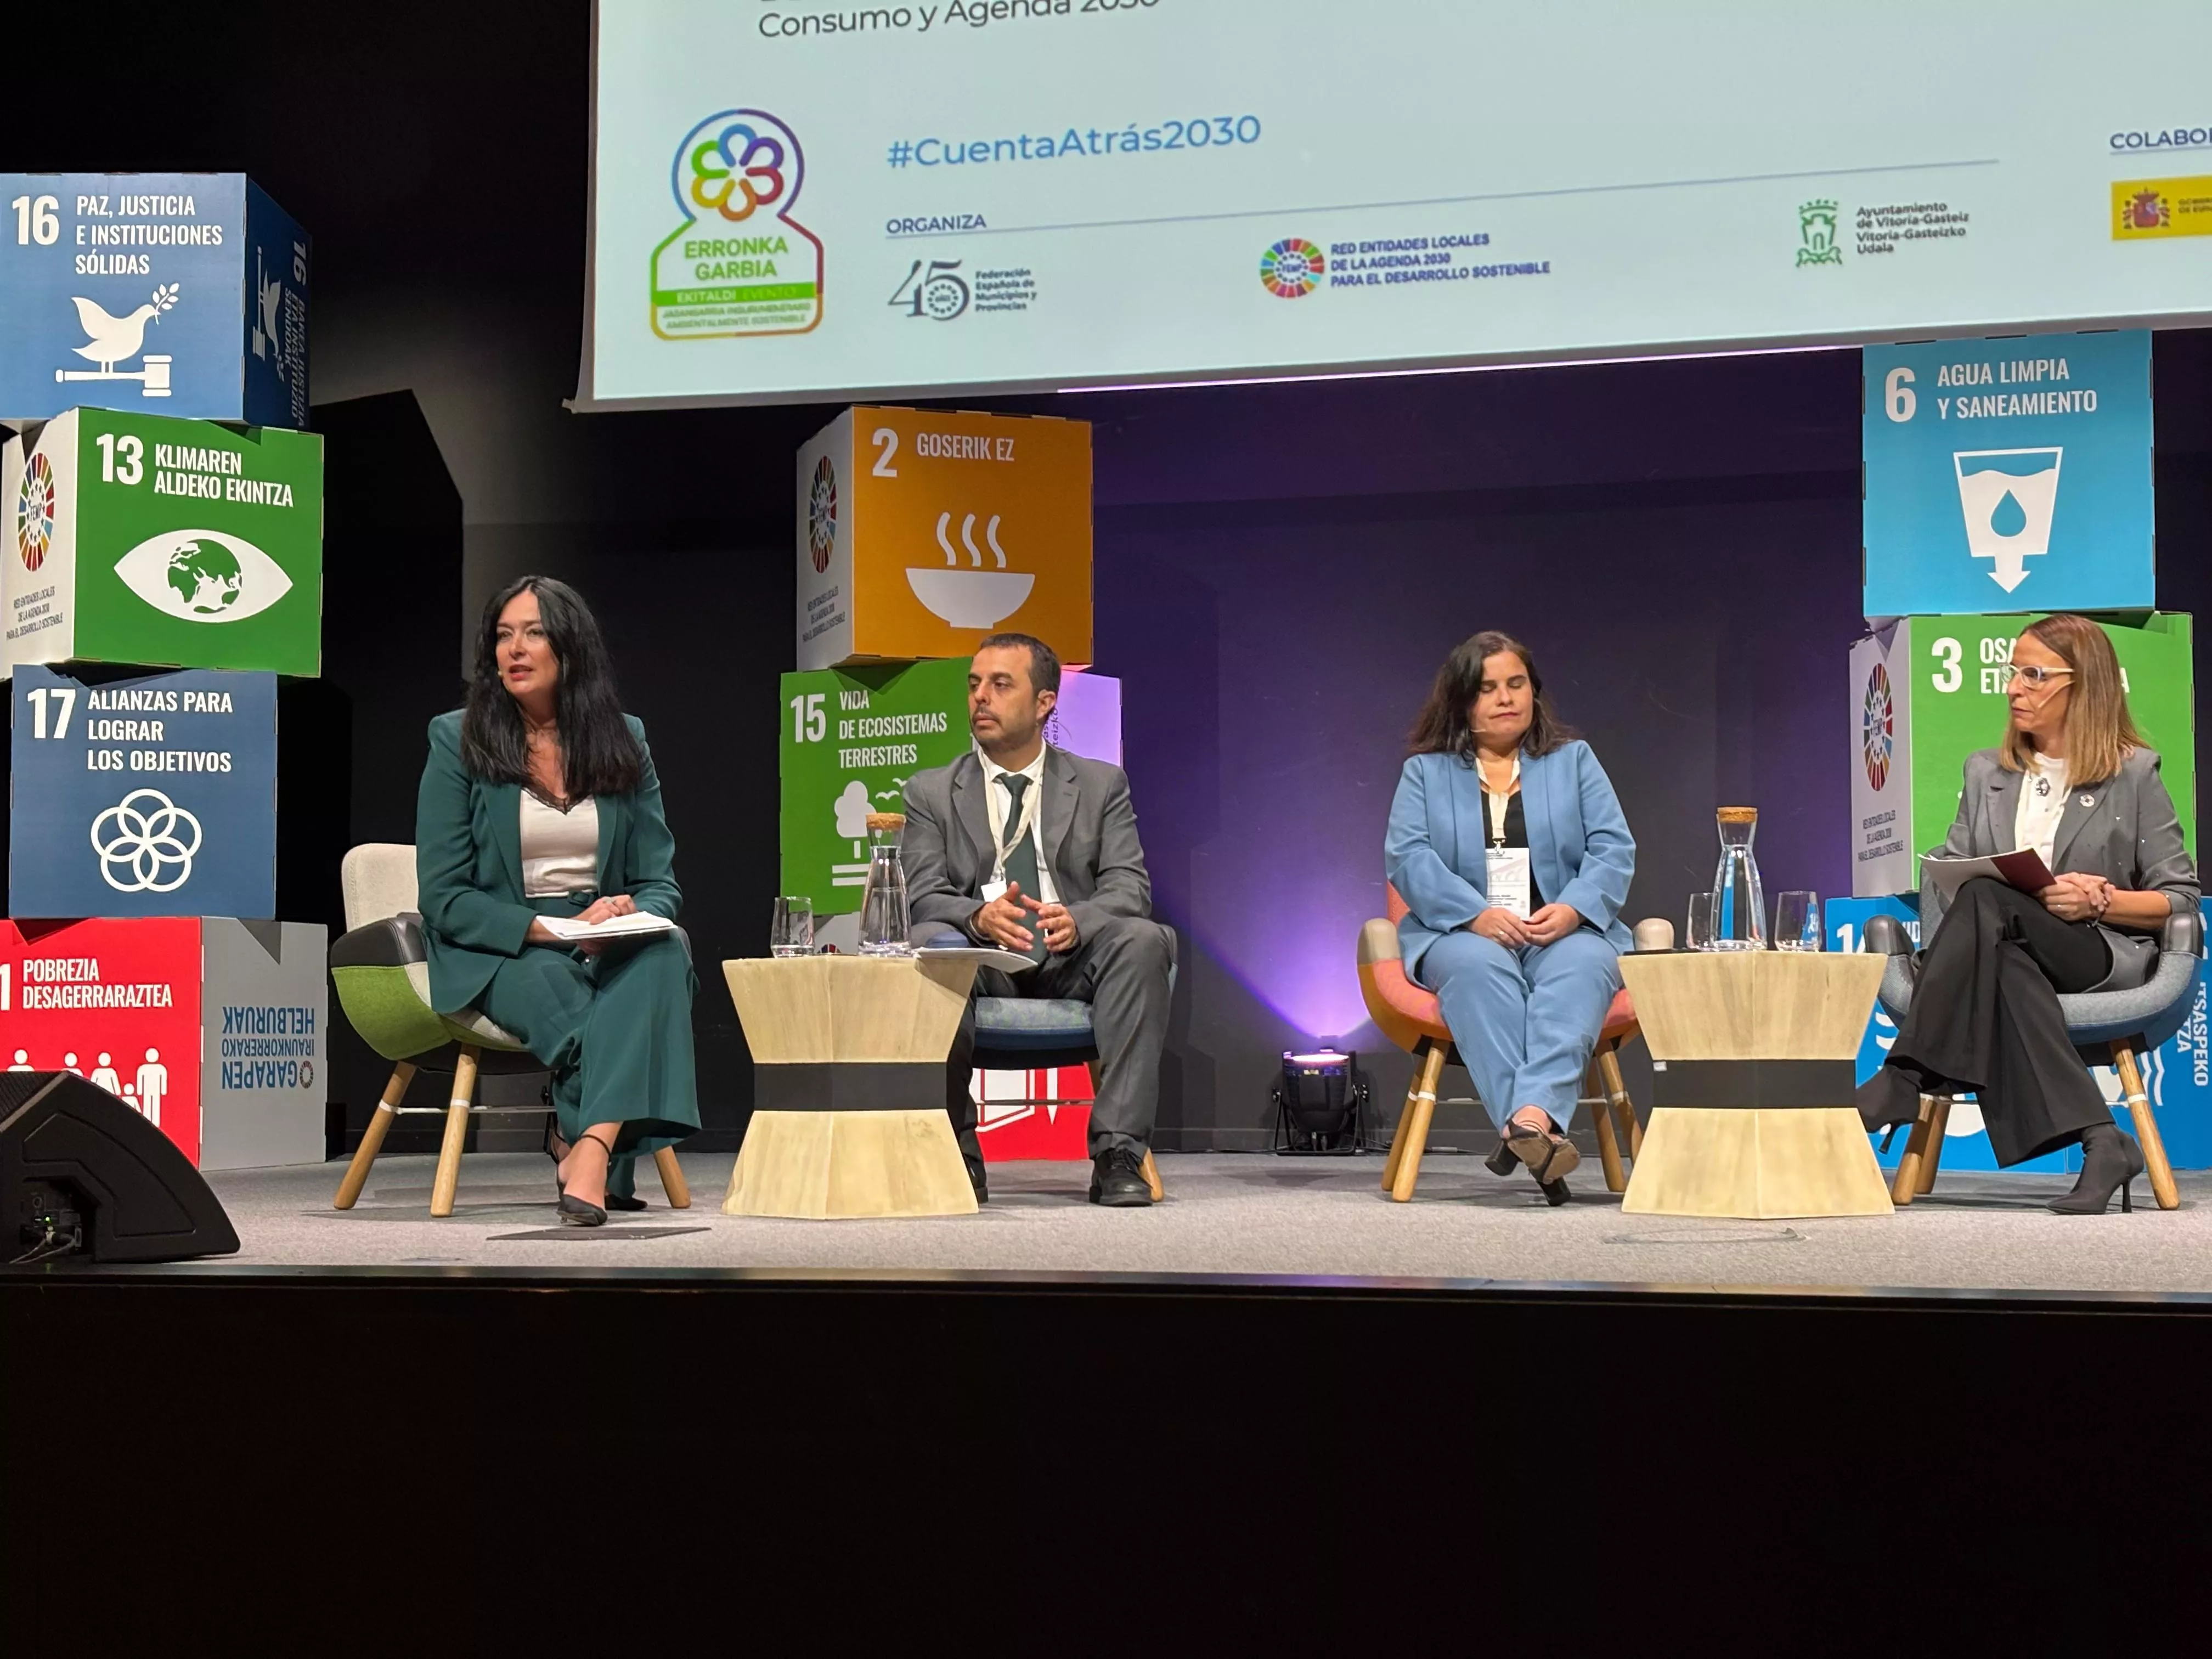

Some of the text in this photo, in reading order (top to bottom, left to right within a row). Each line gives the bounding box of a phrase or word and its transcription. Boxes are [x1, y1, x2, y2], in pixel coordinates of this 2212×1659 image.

[759, 7, 912, 37] Consumo
[917, 5, 938, 32] y
[944, 0, 1070, 27] Agenda
[887, 115, 1261, 167] #CuentaAtrás2030
[2110, 127, 2212, 149] COLABO
[77, 195, 195, 217] PAZ, JUSTICIA
[1856, 202, 1948, 218] Ayuntamiento
[12, 195, 59, 245] 16
[886, 214, 987, 234] ORGANIZA
[1856, 211, 1970, 229] de Vitoria-Gasteiz
[76, 225, 222, 245] E INSTITUCIONES
[1331, 233, 1490, 255] RED ENTIDADES LOCALES
[1857, 227, 1966, 242] Vitoria-Gasteizko
[684, 236, 788, 259] ERRONKA
[1857, 242, 1894, 254] Udala
[76, 250, 150, 274] SÓLIDAS
[294, 240, 307, 286] 16
[695, 259, 777, 281] GARBIA
[975, 268, 1031, 279] Federación
[1330, 261, 1551, 287] PARA EL DESARROLLO SOSTENIBLE
[1331, 252, 1451, 272] DE LA AGENDA 2030
[676, 289, 737, 303] EKITALDI
[888, 259, 969, 321] 45
[1937, 358, 2069, 387] AGUA LIMPIA
[1884, 367, 1916, 422] 6
[1937, 390, 2097, 419] Y SANEAMIENTO
[96, 433, 144, 484] 13
[155, 444, 242, 475] KLIMAREN
[872, 428, 899, 478] 2
[917, 433, 1014, 461] GOSERIK EZ
[154, 471, 294, 507] ALDEKO EKINTZA
[1931, 637, 1963, 693] 3
[1980, 668, 2008, 694] ET
[88, 690, 233, 713] ALIANZAS PARA
[839, 690, 870, 710] VIDA
[27, 688, 76, 739] 17
[790, 693, 826, 743] 15
[88, 719, 163, 741] LOGRAR
[839, 713, 947, 740] DE ECOSISTEMAS
[87, 749, 232, 772] LOS OBJETIVOS
[839, 744, 917, 769] TERRESTRES
[1837, 923, 1866, 953] 1
[23, 958, 100, 982] POBREZIA
[22, 984, 173, 1008] DESAGERRARAZTEA
[222, 1006, 315, 1034] HELBURUAK
[222, 1038, 315, 1057] IRAUNKORRERAKO
[222, 1060, 297, 1090] GARAPEN
